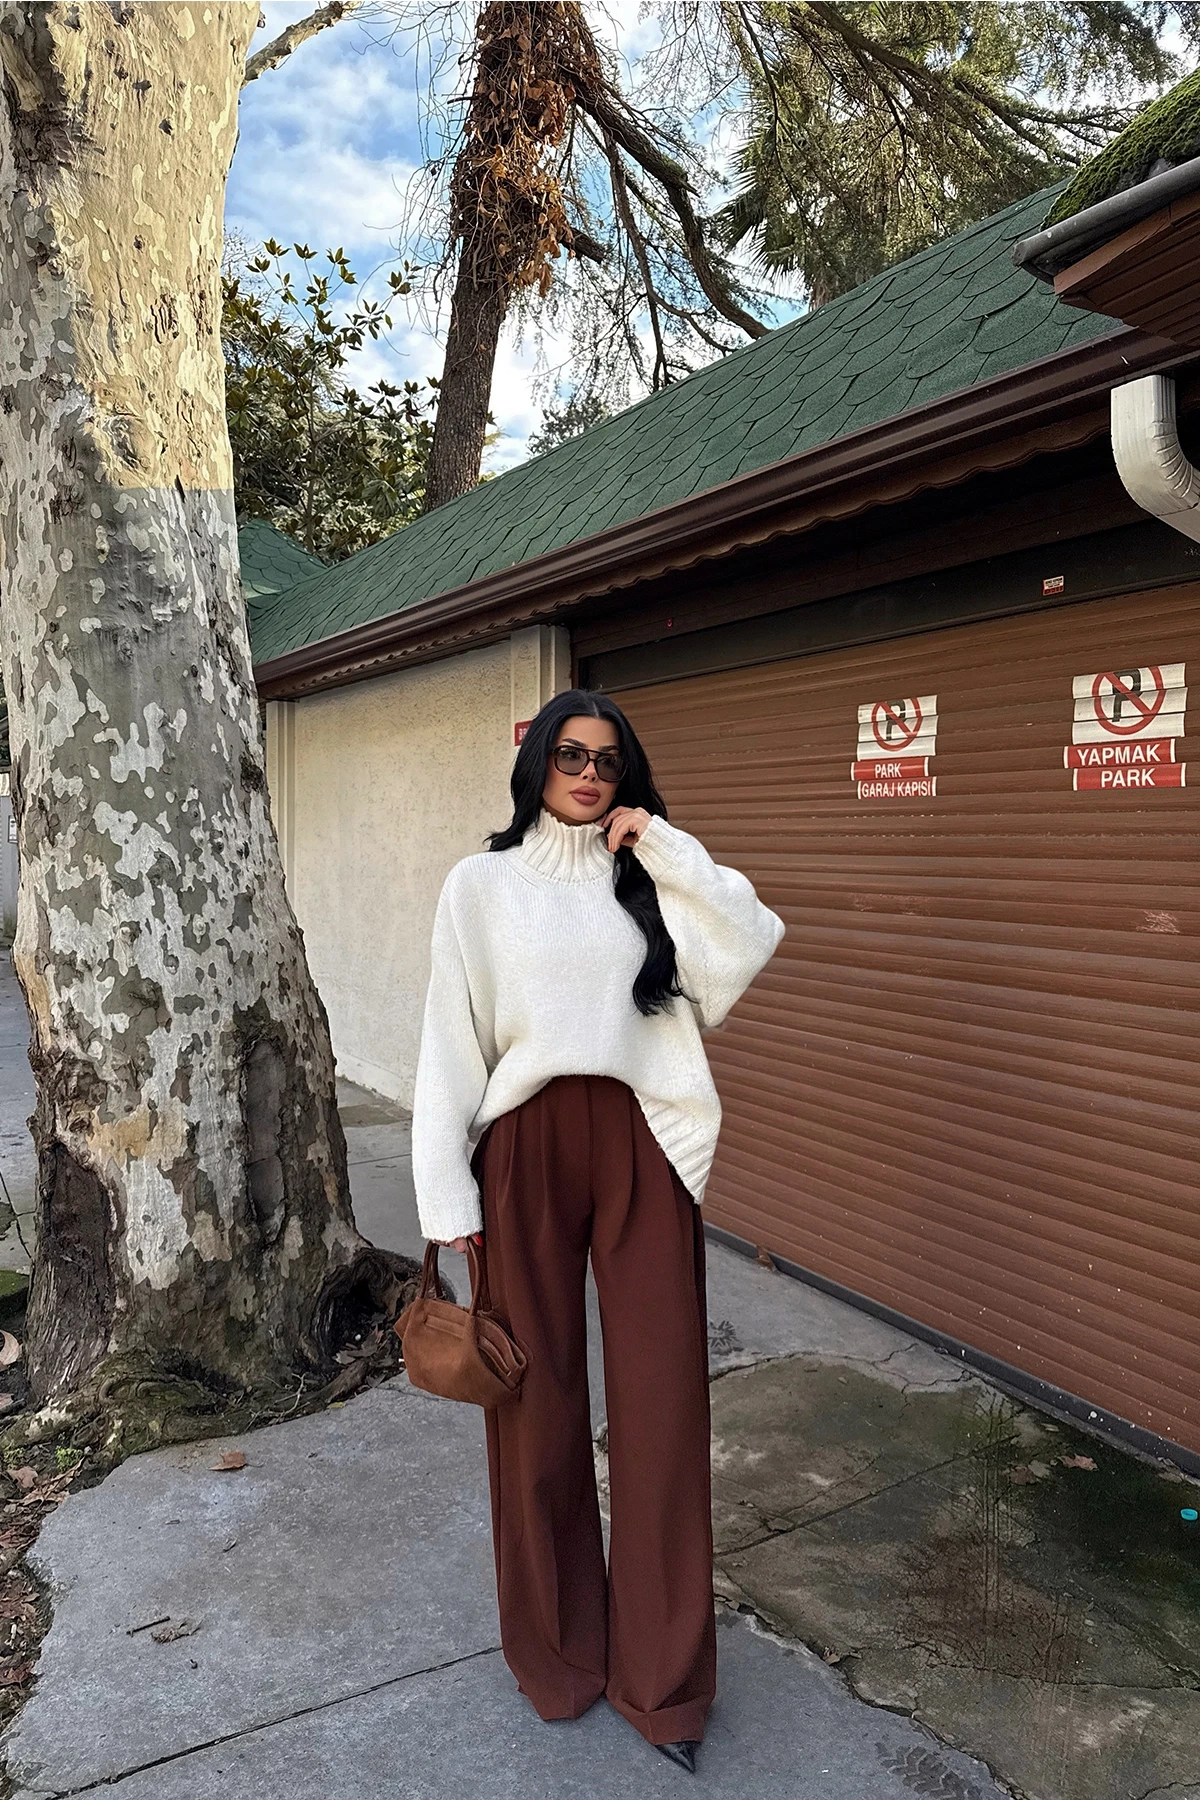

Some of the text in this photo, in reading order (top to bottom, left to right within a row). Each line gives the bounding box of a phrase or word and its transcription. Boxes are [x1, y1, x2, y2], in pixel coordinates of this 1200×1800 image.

[1077, 744, 1161, 766] YAPMAK
[875, 763, 902, 778] PARK
[1101, 768, 1156, 788] PARK
[861, 780, 931, 798] GARAJ KAPISI
